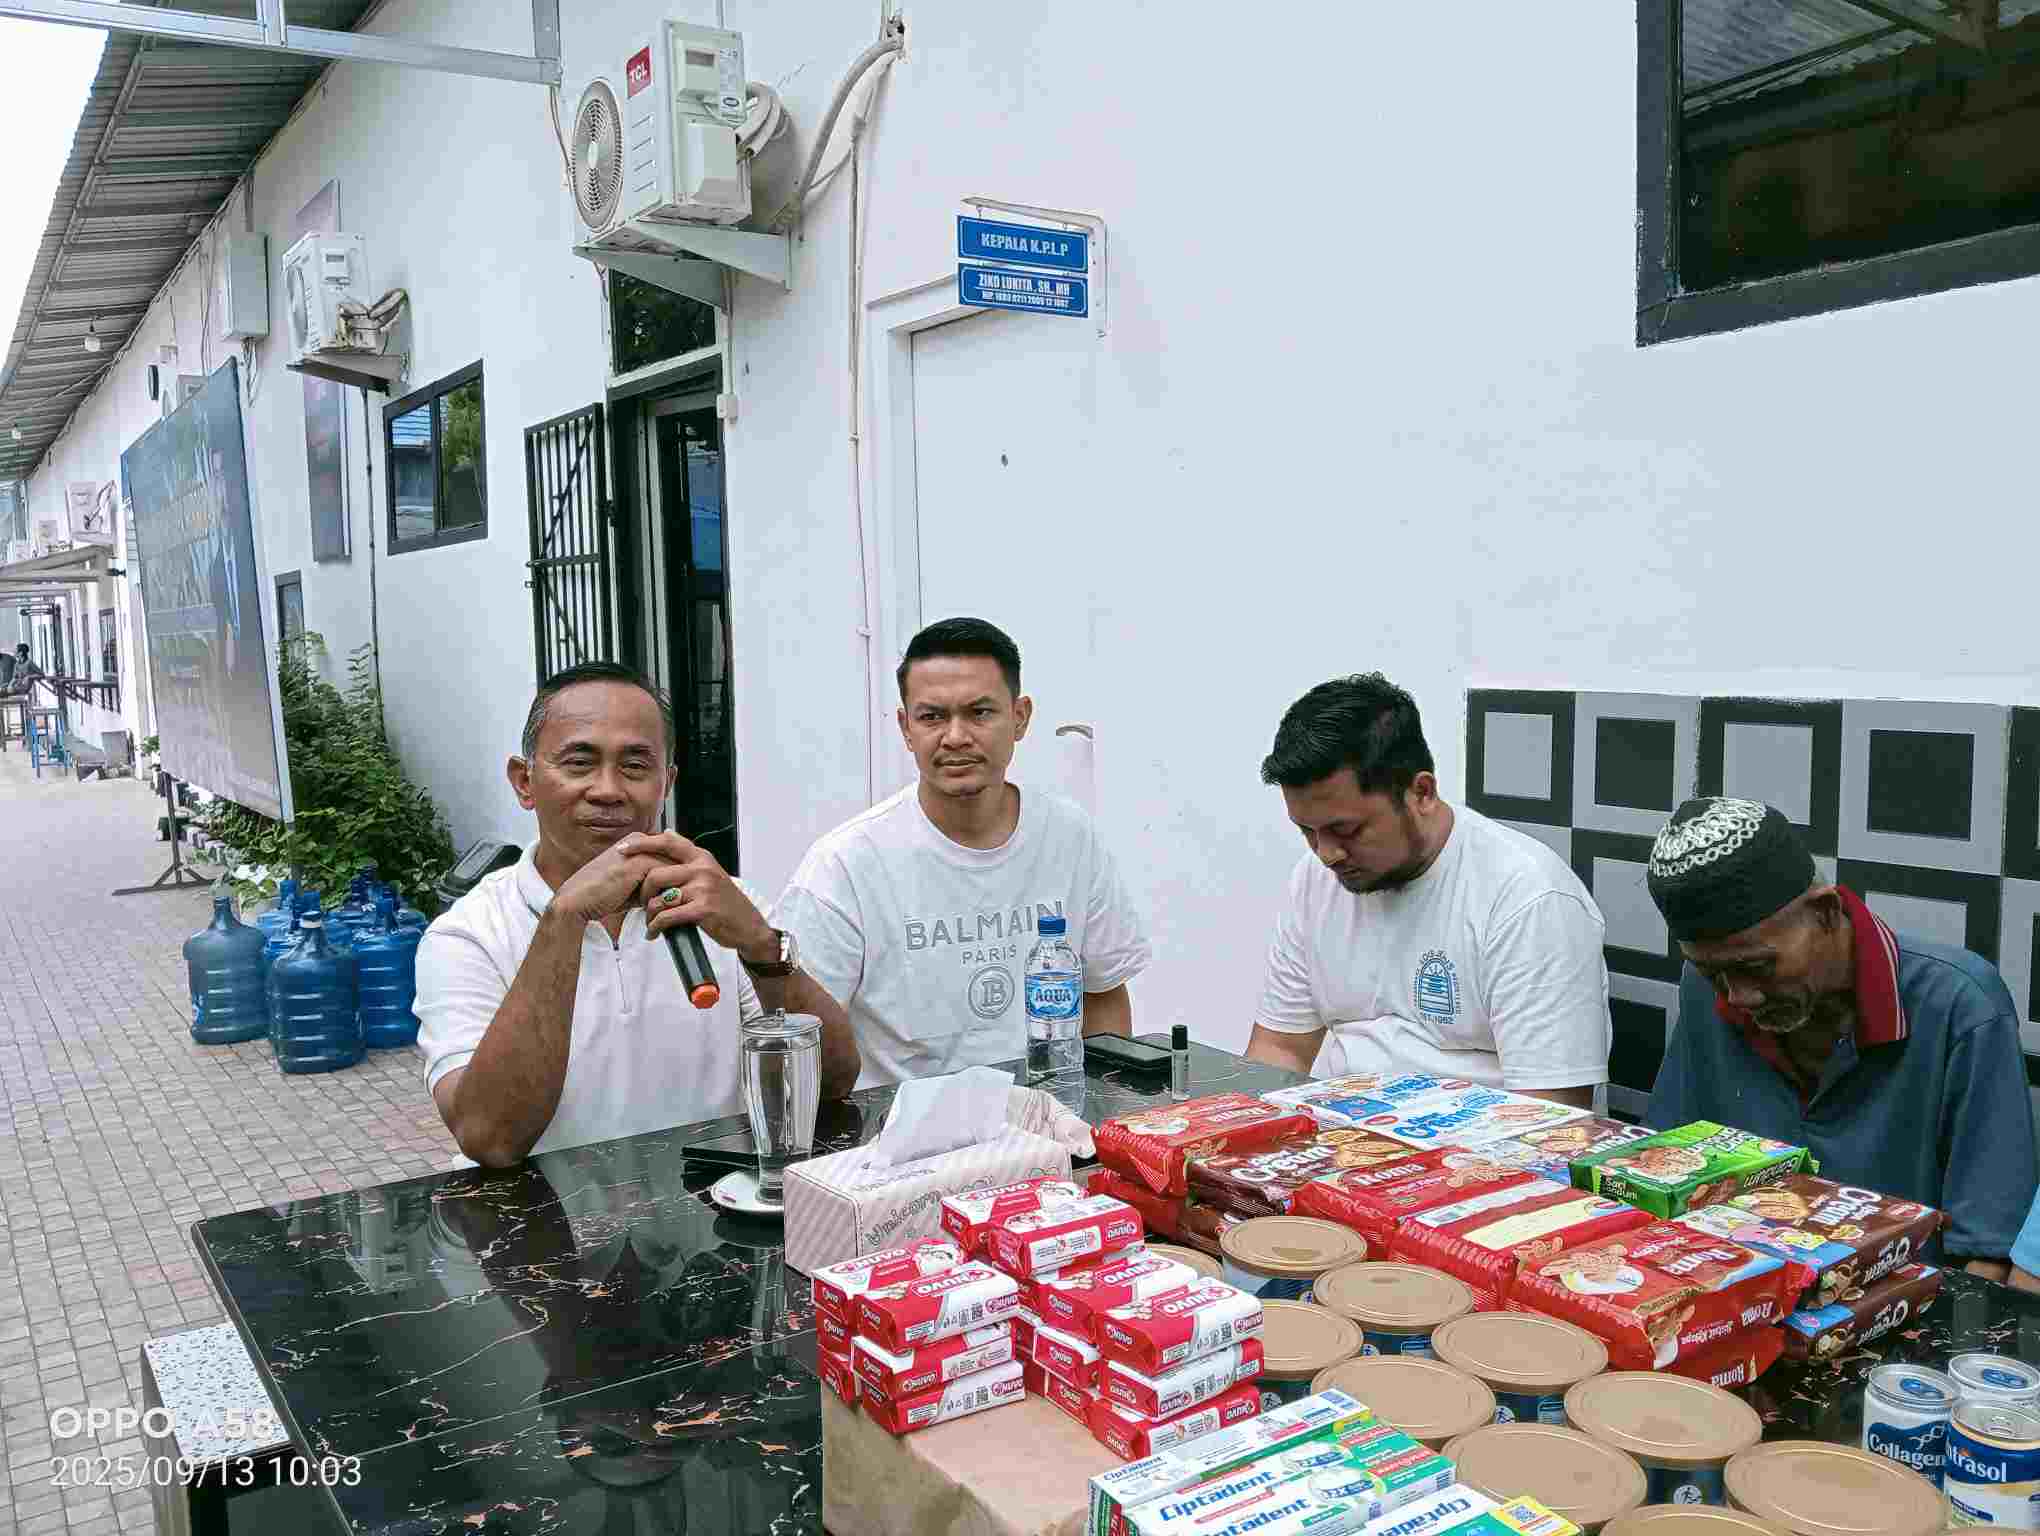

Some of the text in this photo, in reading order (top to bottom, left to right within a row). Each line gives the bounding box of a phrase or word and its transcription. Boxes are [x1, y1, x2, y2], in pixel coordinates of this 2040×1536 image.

[629, 64, 648, 83] TCL
[981, 233, 1029, 253] KEPALA
[961, 943, 1018, 965] PARIS
[1034, 987, 1073, 1002] AQUA
[1353, 1162, 1426, 1186] Roma
[853, 1248, 908, 1267] NUVO
[917, 1271, 968, 1294] NUVO
[1104, 1262, 1152, 1285] NUVO
[1163, 1290, 1210, 1314] NUVO
[1741, 1301, 1774, 1328] Roma
[1711, 1364, 1745, 1388] Roma
[1870, 1434, 1946, 1471] Collagen
[1949, 1444, 2007, 1483] trasol
[1104, 1455, 1163, 1482] Ciptadent
[1160, 1470, 1276, 1522] Ciptadent
[1204, 1498, 1312, 1536] tadent
